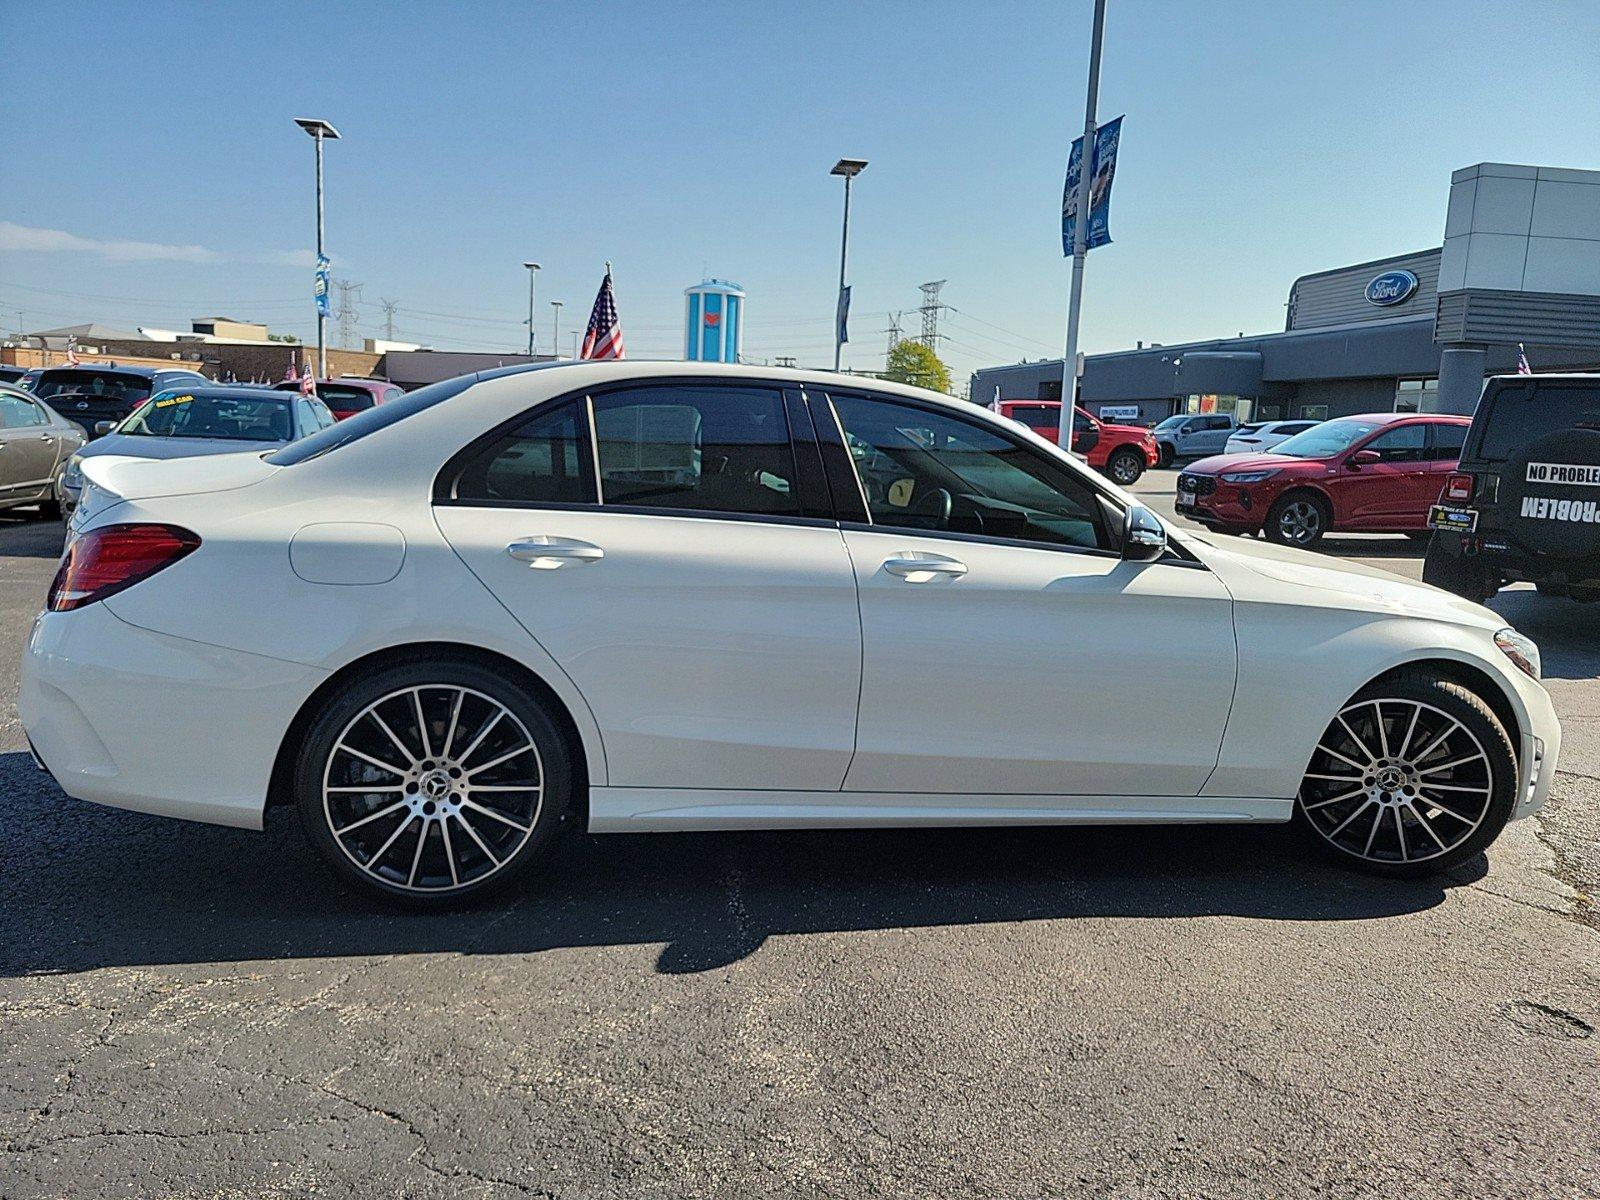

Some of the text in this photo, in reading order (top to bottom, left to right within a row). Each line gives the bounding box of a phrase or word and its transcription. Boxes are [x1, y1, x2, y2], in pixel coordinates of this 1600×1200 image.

[1372, 279, 1401, 299] Ford
[1529, 465, 1600, 484] NO PROBLE
